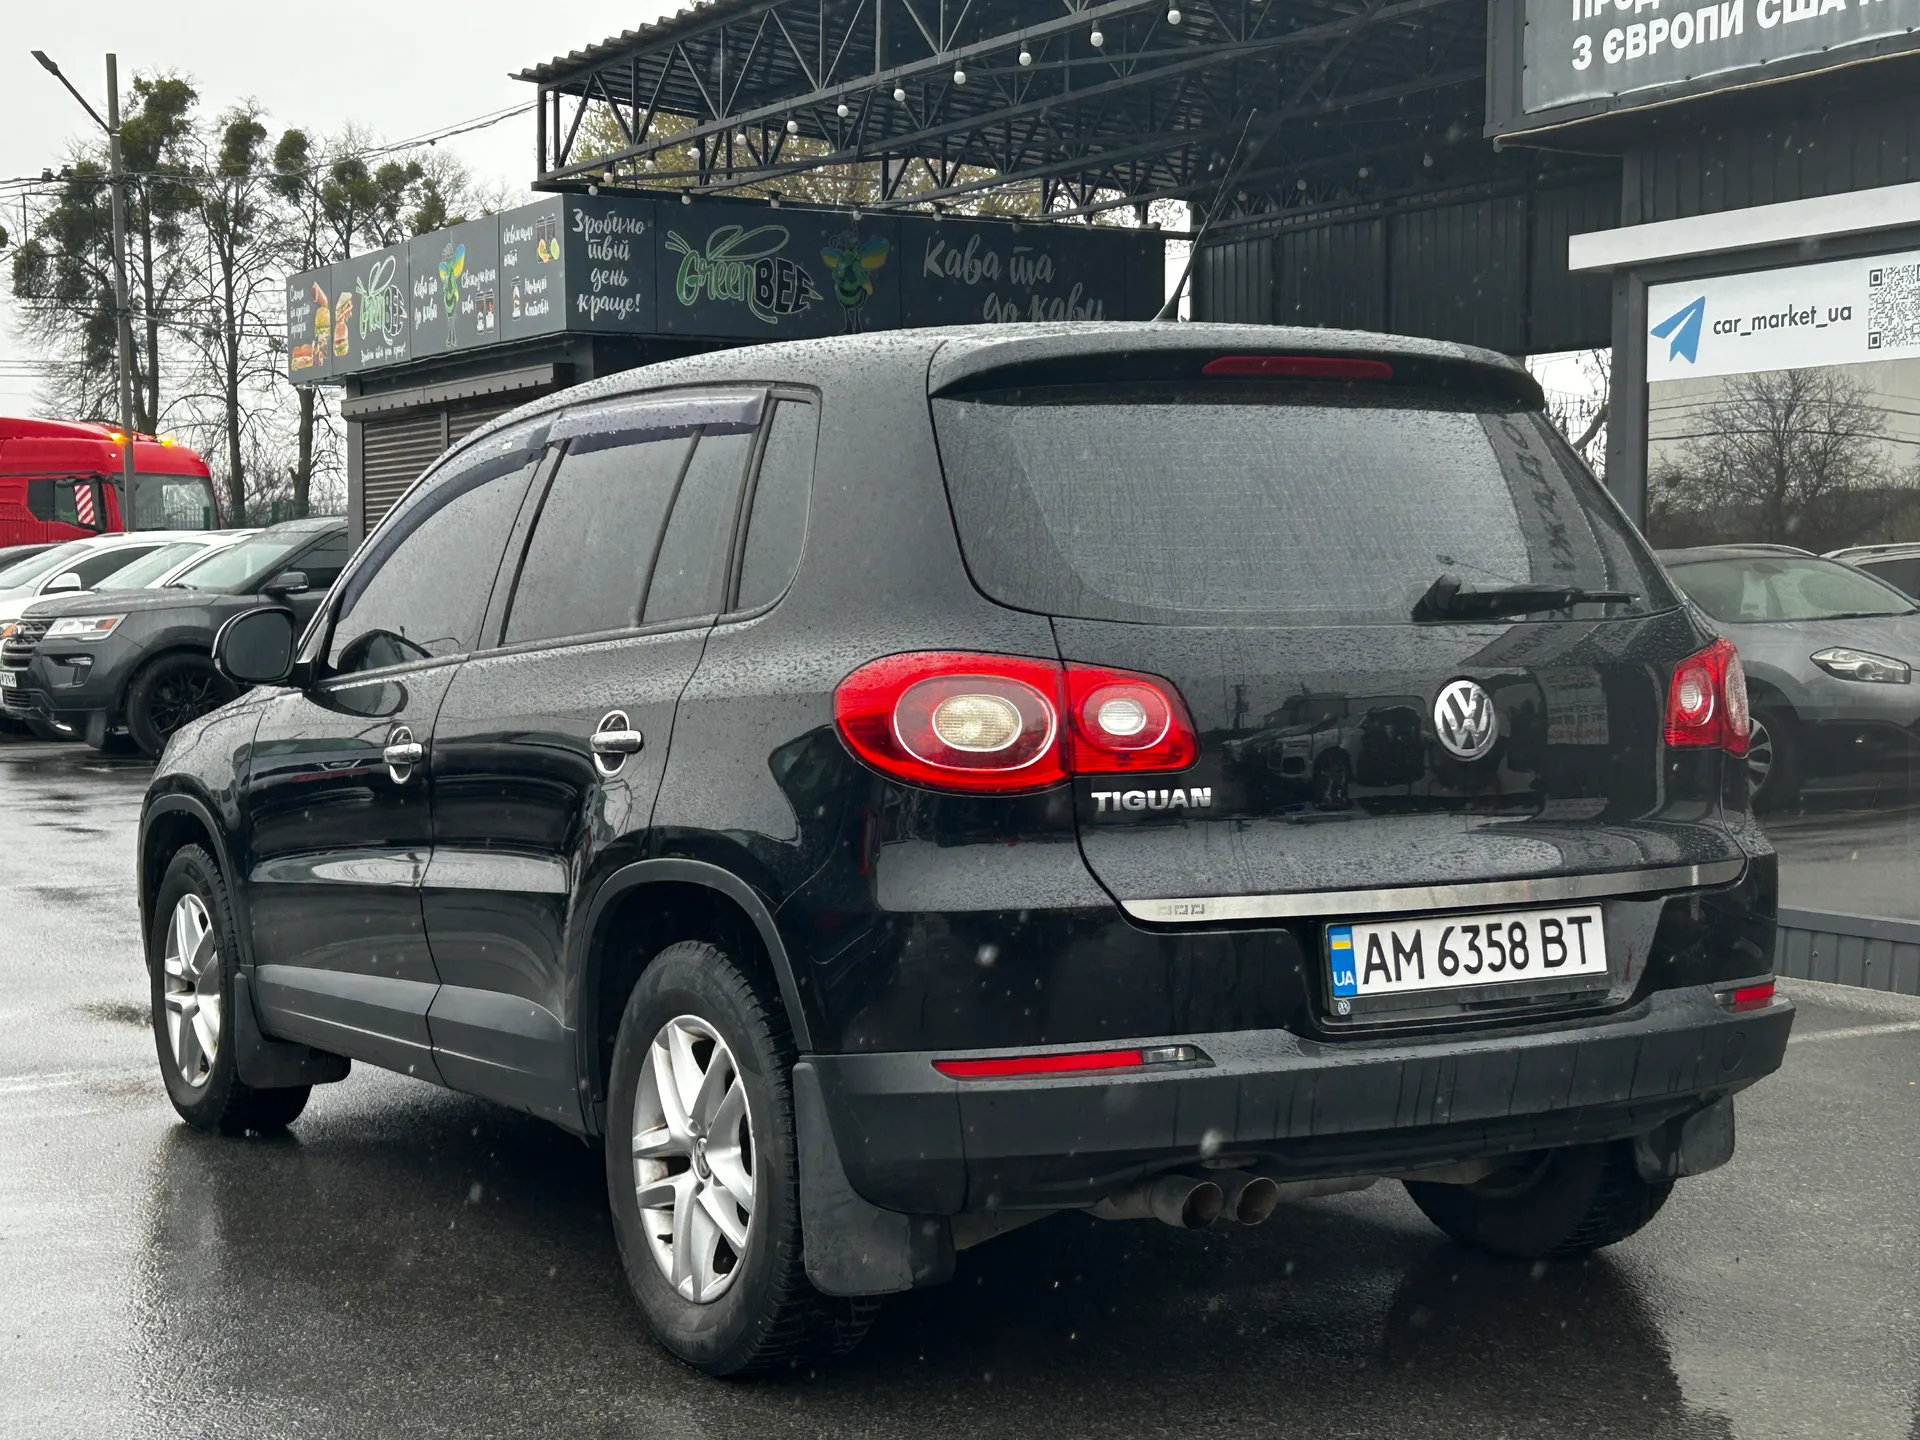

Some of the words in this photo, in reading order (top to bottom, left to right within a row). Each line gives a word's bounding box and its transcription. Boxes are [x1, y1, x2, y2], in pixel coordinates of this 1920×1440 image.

[1571, 34, 1593, 70] З
[1602, 0, 1743, 64] ЄВРОПИ
[572, 207, 646, 242] Зробимо
[587, 235, 631, 262] твій
[923, 233, 1003, 285] Кава
[1009, 246, 1056, 286] та
[590, 266, 629, 292] день
[577, 293, 641, 321] краще!
[1713, 303, 1852, 337] car_market_ua
[1091, 787, 1212, 812] TIGUAN
[1362, 929, 1425, 985] AM
[1437, 920, 1530, 977] 6358
[1539, 915, 1592, 968] BT
[1333, 970, 1355, 986] UA
